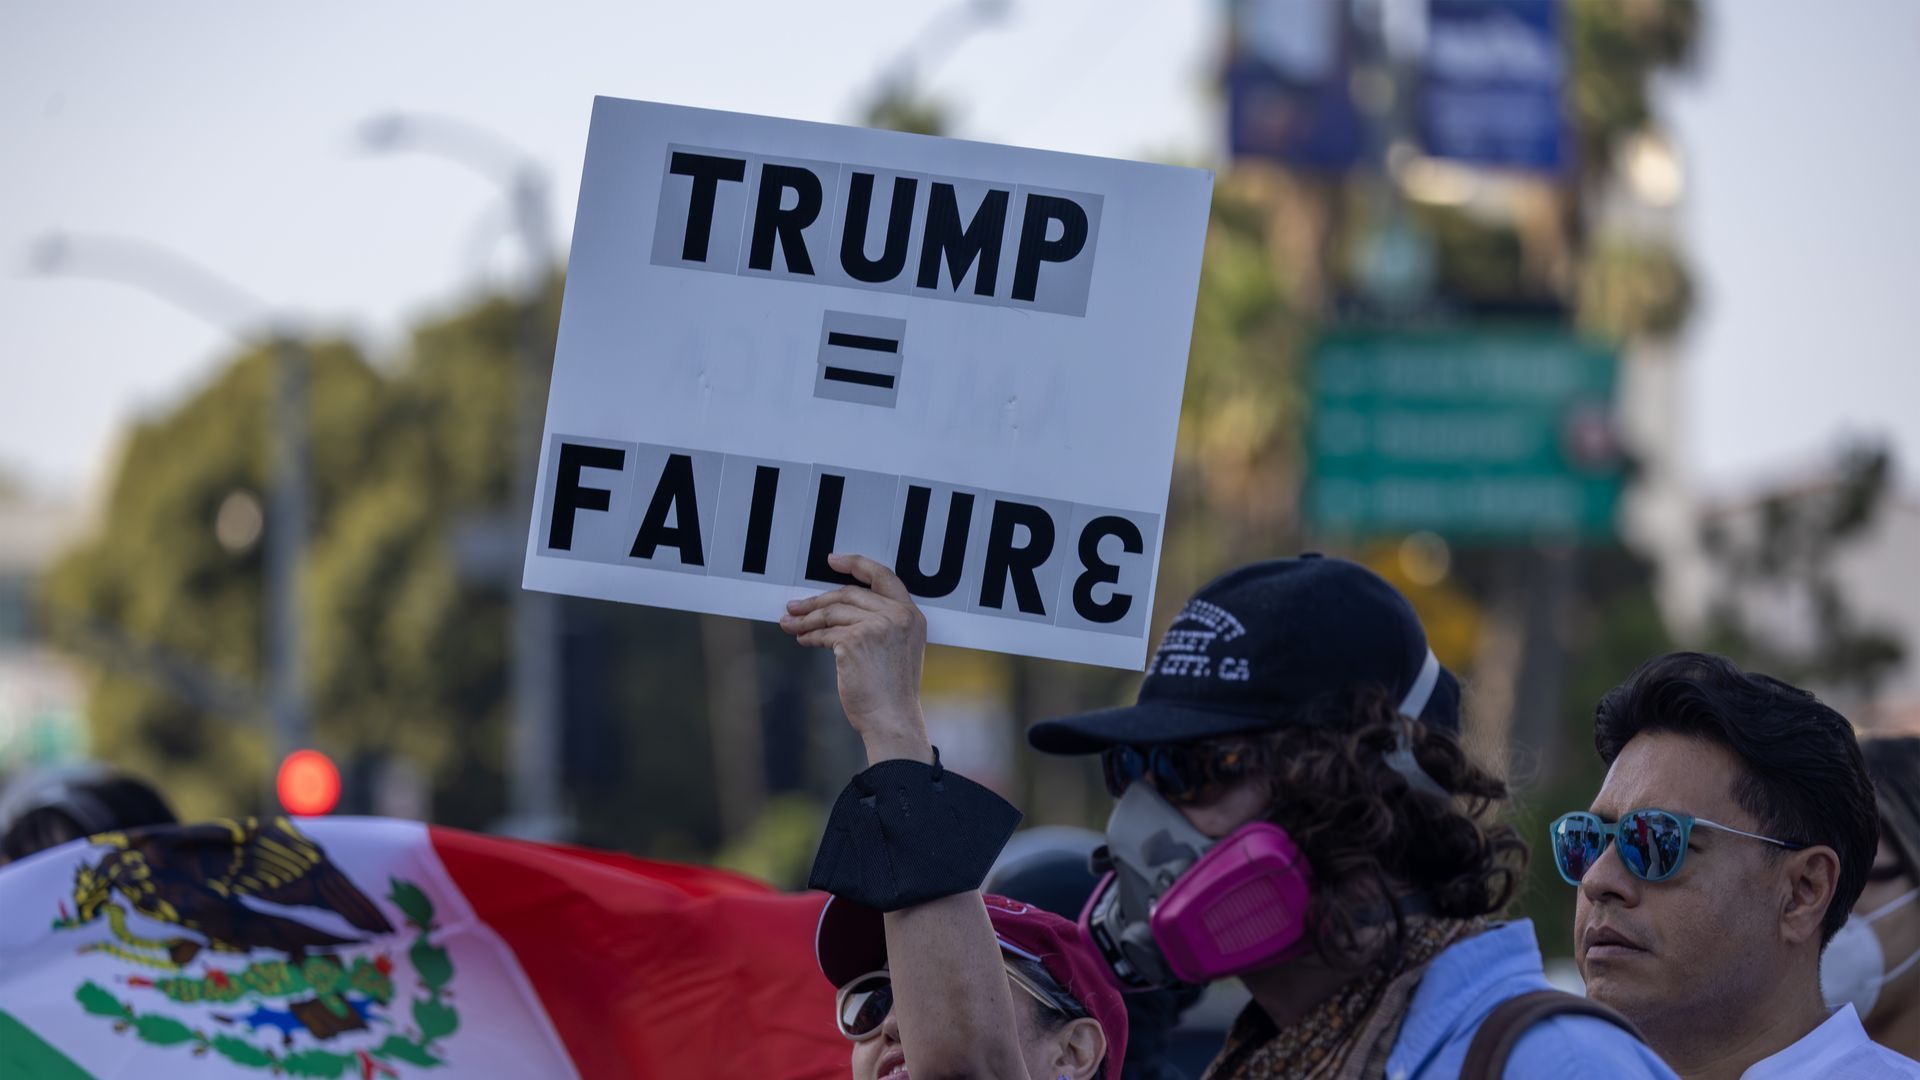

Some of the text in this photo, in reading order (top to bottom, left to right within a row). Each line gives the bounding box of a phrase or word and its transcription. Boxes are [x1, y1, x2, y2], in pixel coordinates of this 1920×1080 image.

[670, 151, 1089, 303] TRUMP
[824, 331, 899, 390] =
[548, 442, 1144, 624] FAILURE
